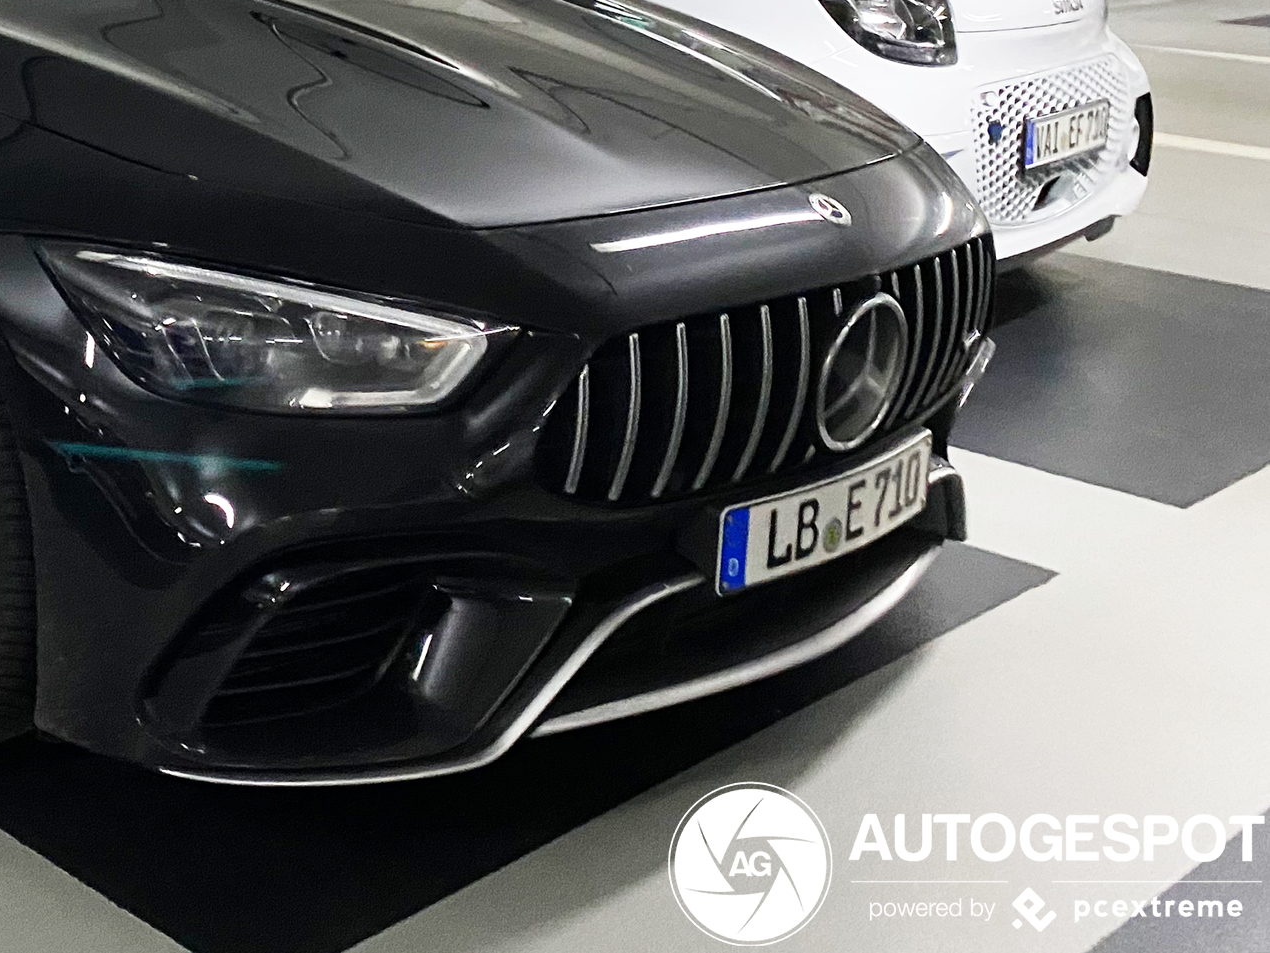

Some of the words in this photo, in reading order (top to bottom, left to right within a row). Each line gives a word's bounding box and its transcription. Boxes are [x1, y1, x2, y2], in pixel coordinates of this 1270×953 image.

[1035, 121, 1059, 159] VAI
[1069, 113, 1084, 148] EF
[767, 498, 820, 569] LB
[845, 478, 866, 541] E
[874, 449, 921, 527] 710
